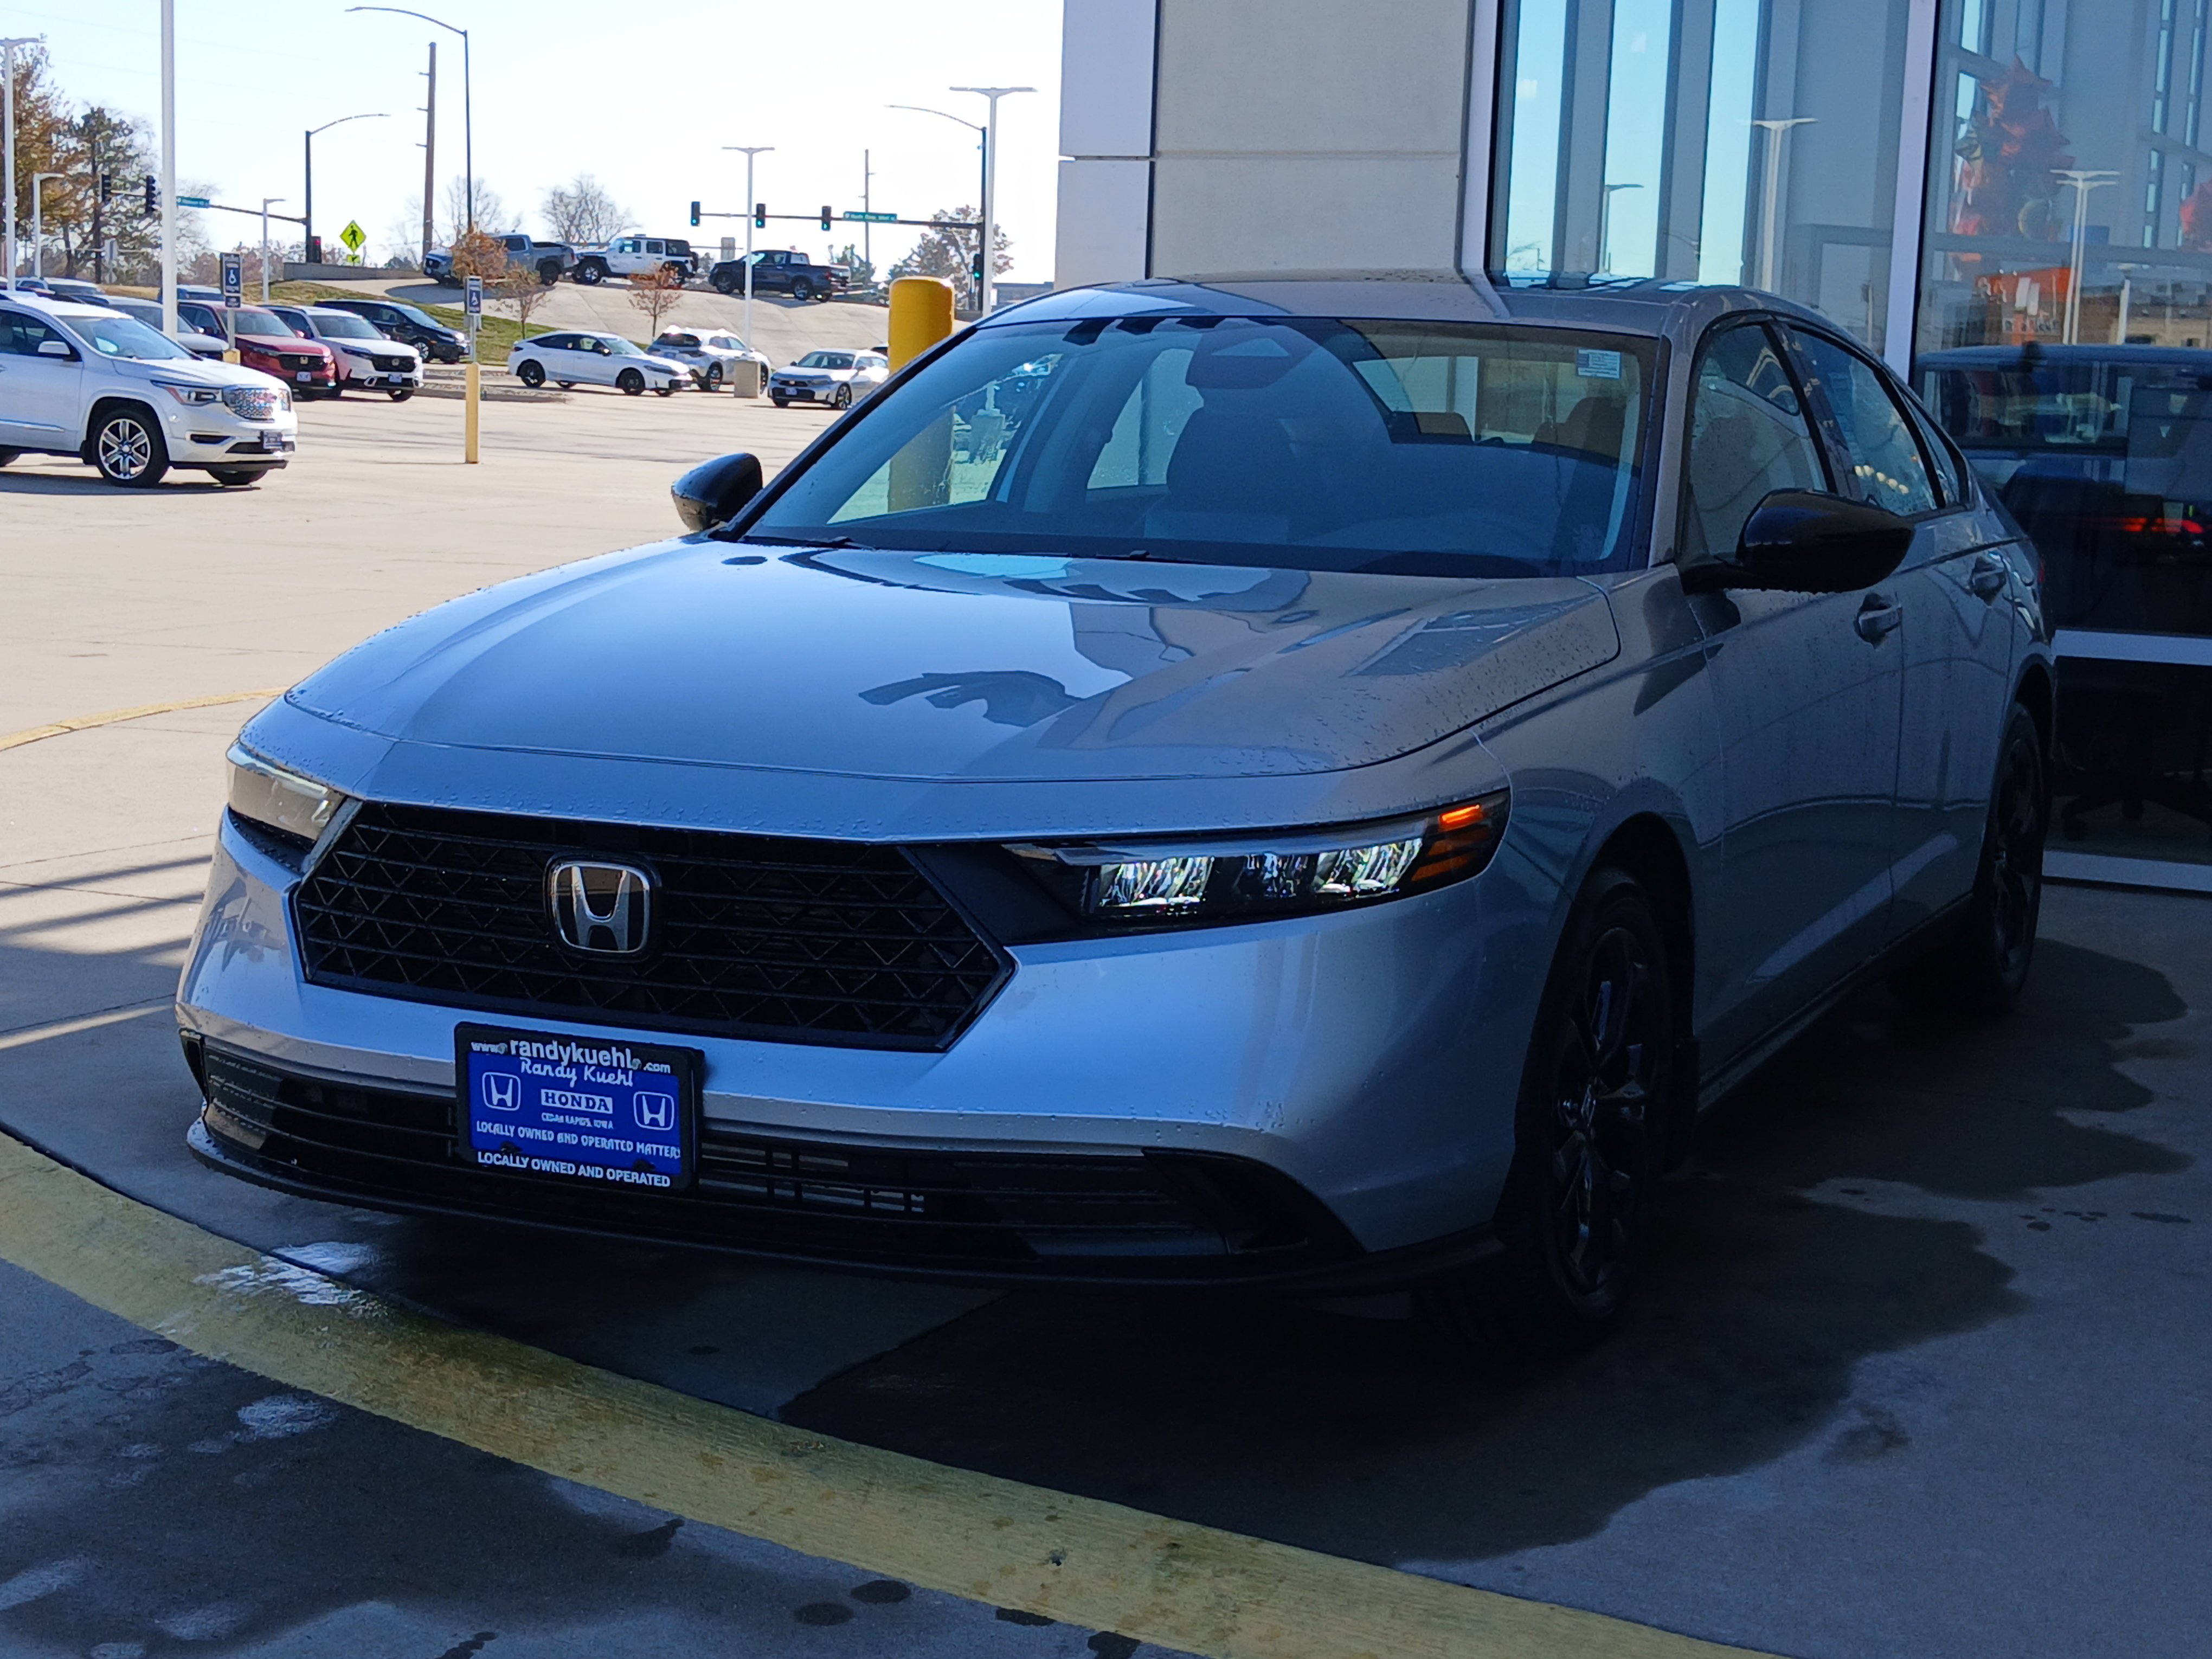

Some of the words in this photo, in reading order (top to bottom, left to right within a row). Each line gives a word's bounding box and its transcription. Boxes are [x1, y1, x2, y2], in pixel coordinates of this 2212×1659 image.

[519, 1057, 577, 1088] Randy
[584, 1065, 633, 1088] Kuehl
[544, 1091, 610, 1112] HONDA
[476, 1120, 516, 1138] LOCALLY
[517, 1126, 555, 1142] OWNED
[557, 1132, 578, 1145] AND
[581, 1135, 634, 1153] OPERATED
[477, 1151, 530, 1168] LOCALLY
[531, 1158, 576, 1175] OWNED
[577, 1164, 604, 1179] AND
[606, 1168, 671, 1187] OPERATED
